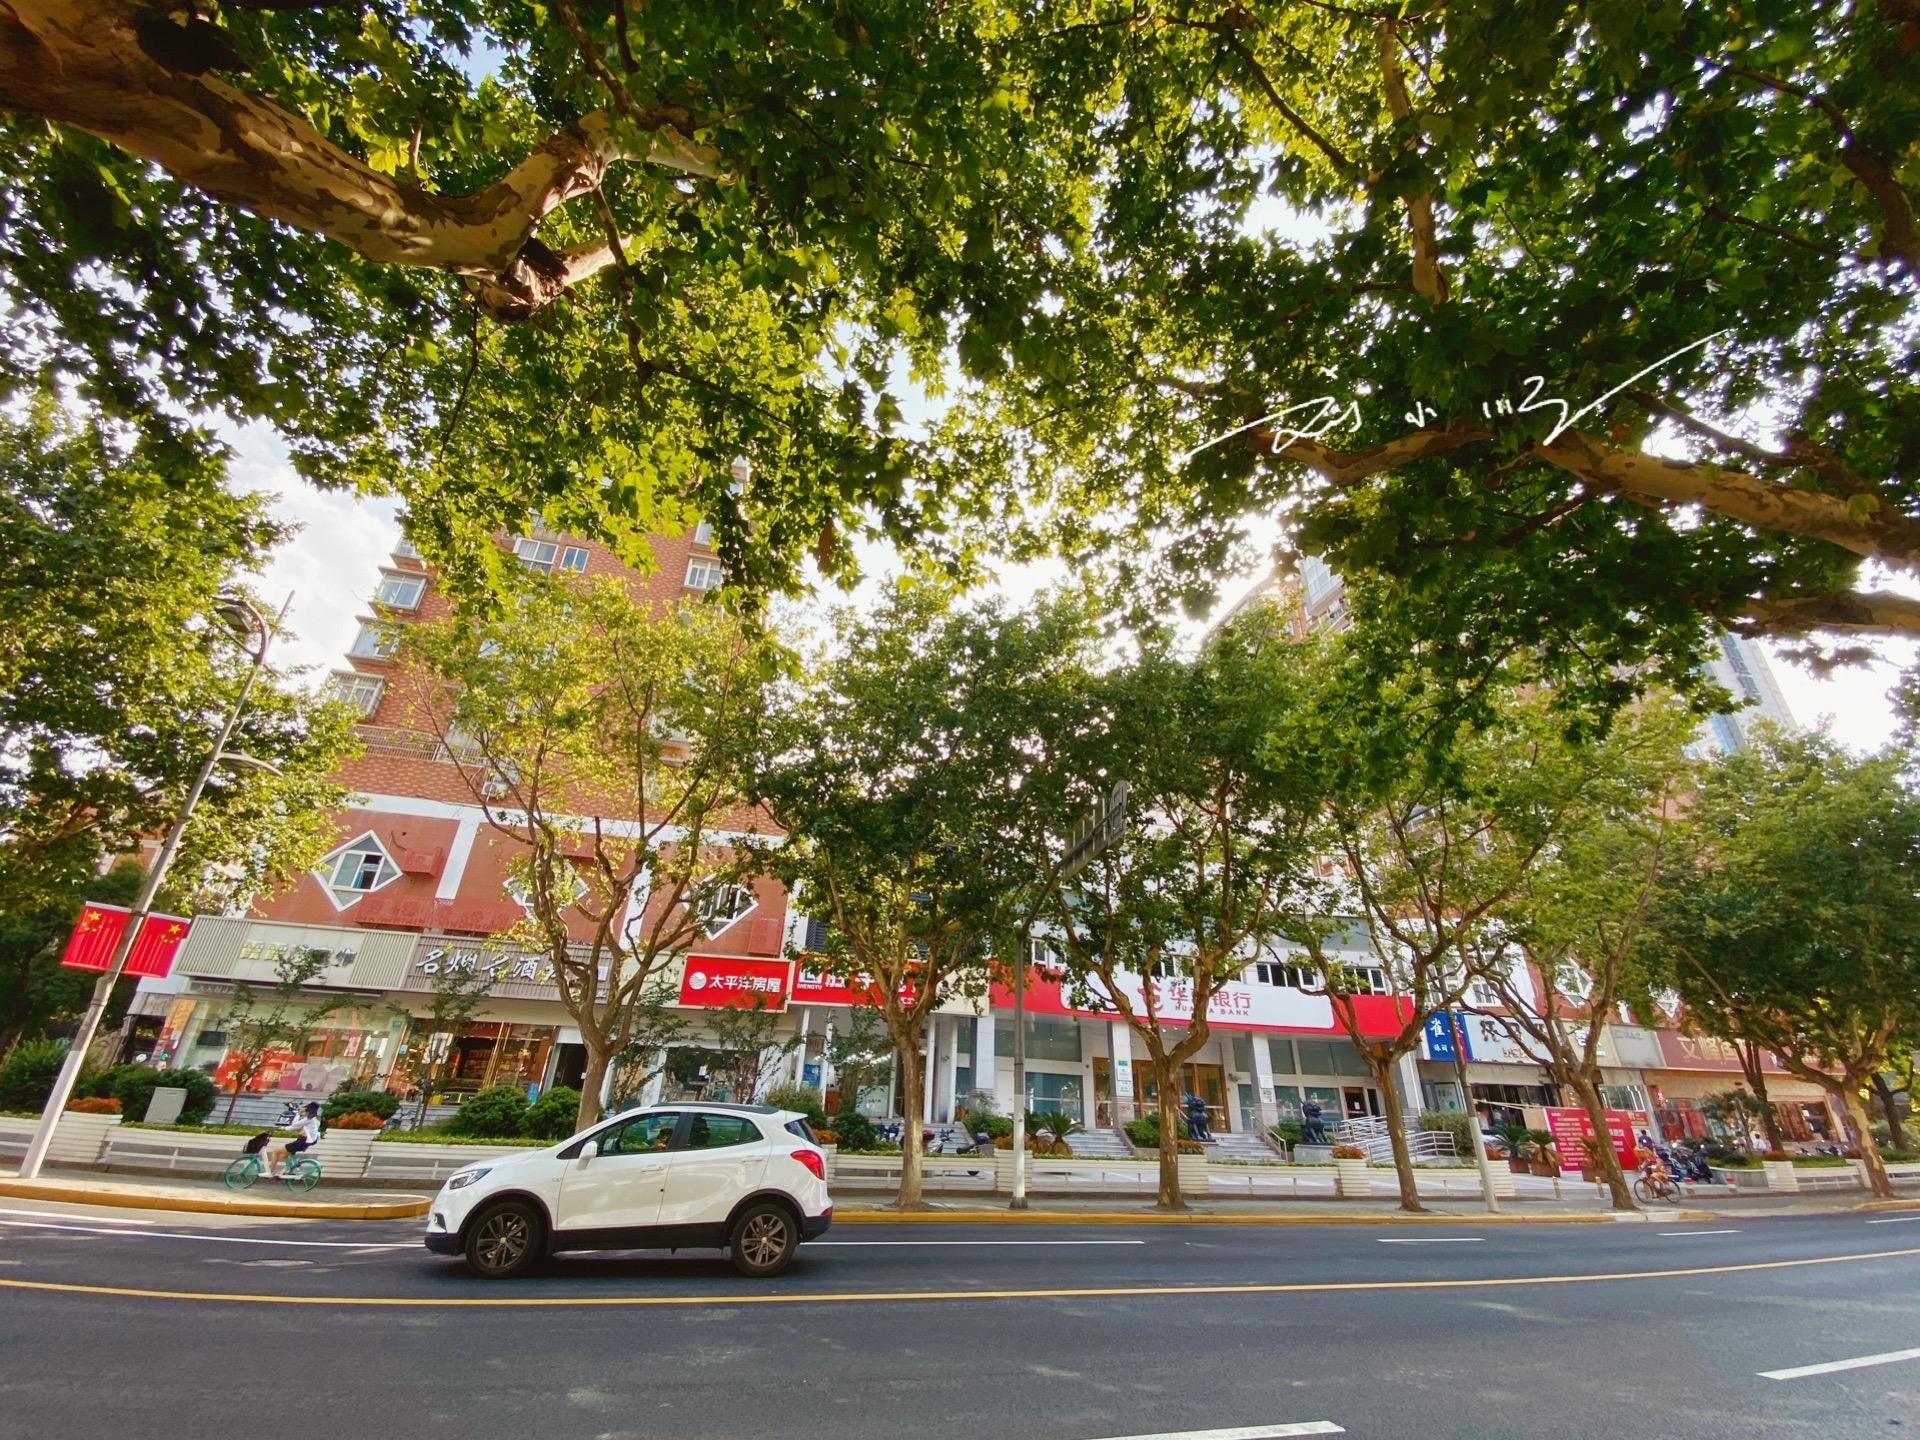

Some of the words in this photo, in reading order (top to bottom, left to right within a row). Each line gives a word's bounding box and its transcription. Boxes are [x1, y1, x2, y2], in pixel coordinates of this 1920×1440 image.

[709, 974, 782, 993] 太平洋房屋
[797, 983, 823, 991] SHENGYU
[1168, 983, 1252, 1010] 华银行
